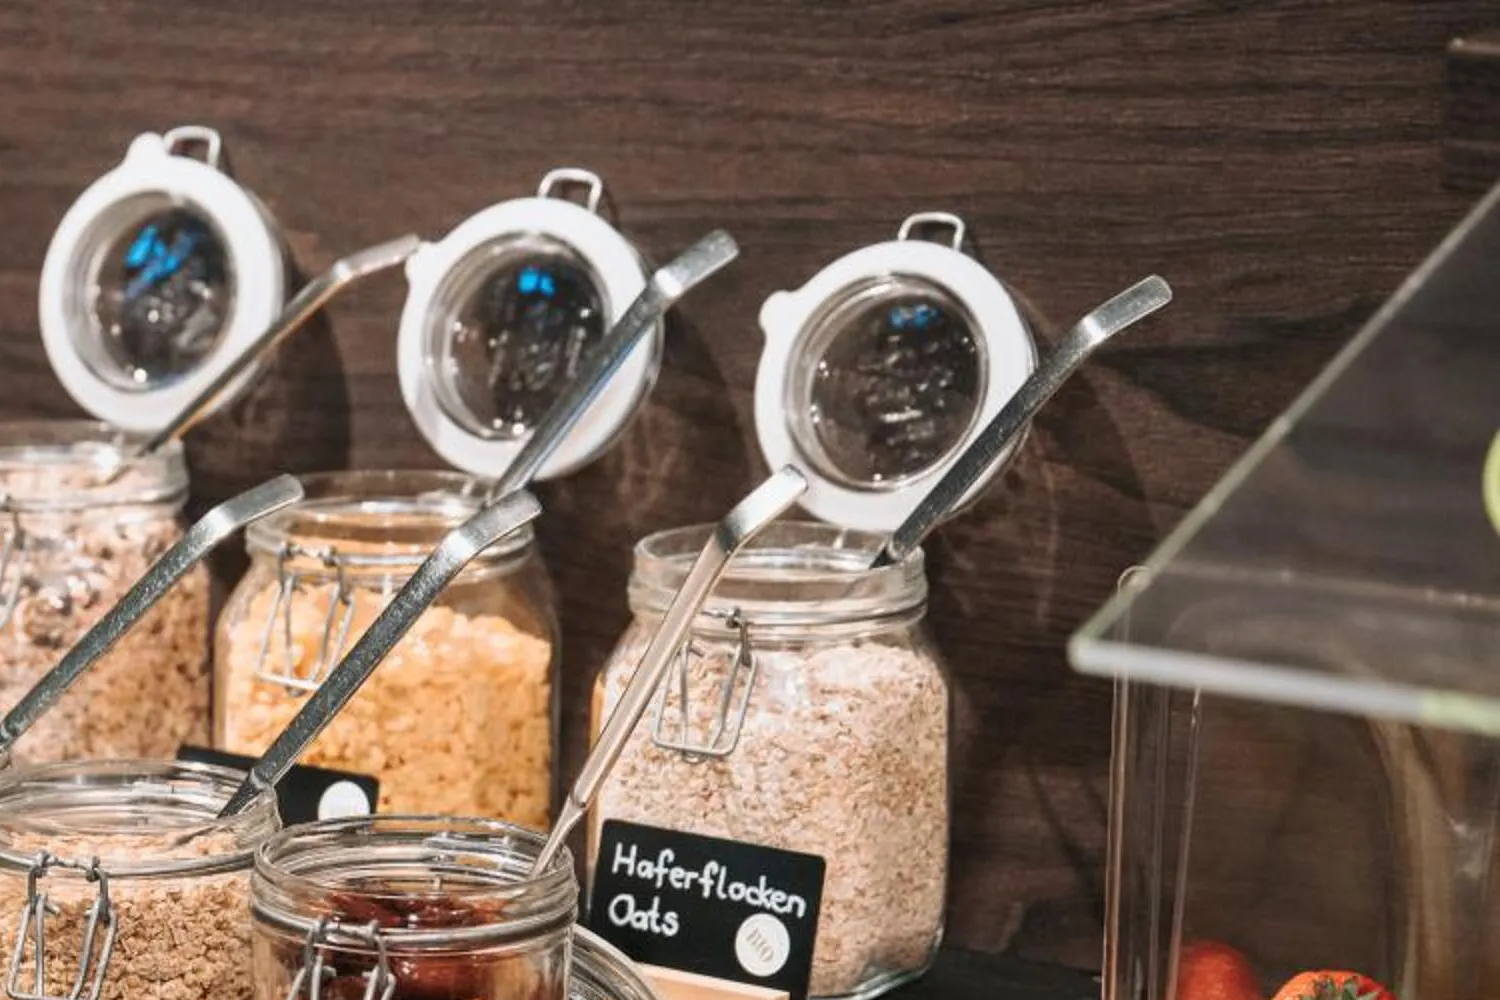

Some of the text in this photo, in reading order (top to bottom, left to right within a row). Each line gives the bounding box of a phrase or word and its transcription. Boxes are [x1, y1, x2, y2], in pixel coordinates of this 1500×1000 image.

[612, 841, 807, 918] Haferflocken
[608, 893, 680, 937] Oats
[746, 928, 775, 963] BIO
